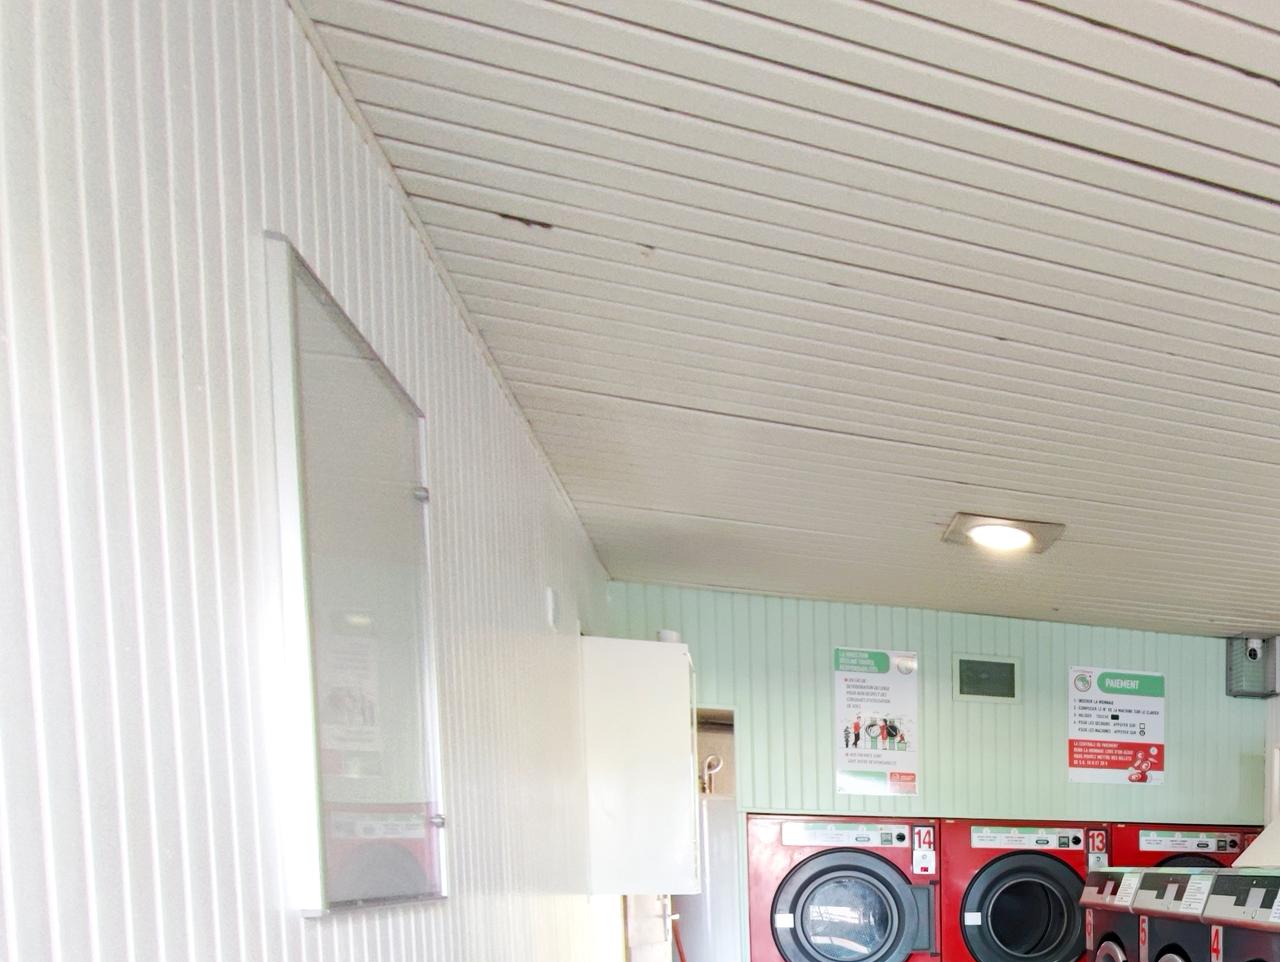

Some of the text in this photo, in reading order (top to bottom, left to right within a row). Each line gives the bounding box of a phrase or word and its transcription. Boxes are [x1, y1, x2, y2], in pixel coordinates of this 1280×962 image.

[1105, 678, 1139, 689] PAIEMENT
[915, 829, 933, 848] 14
[1089, 832, 1105, 851] 13
[1140, 918, 1147, 945] 5
[1210, 928, 1220, 960] 4
